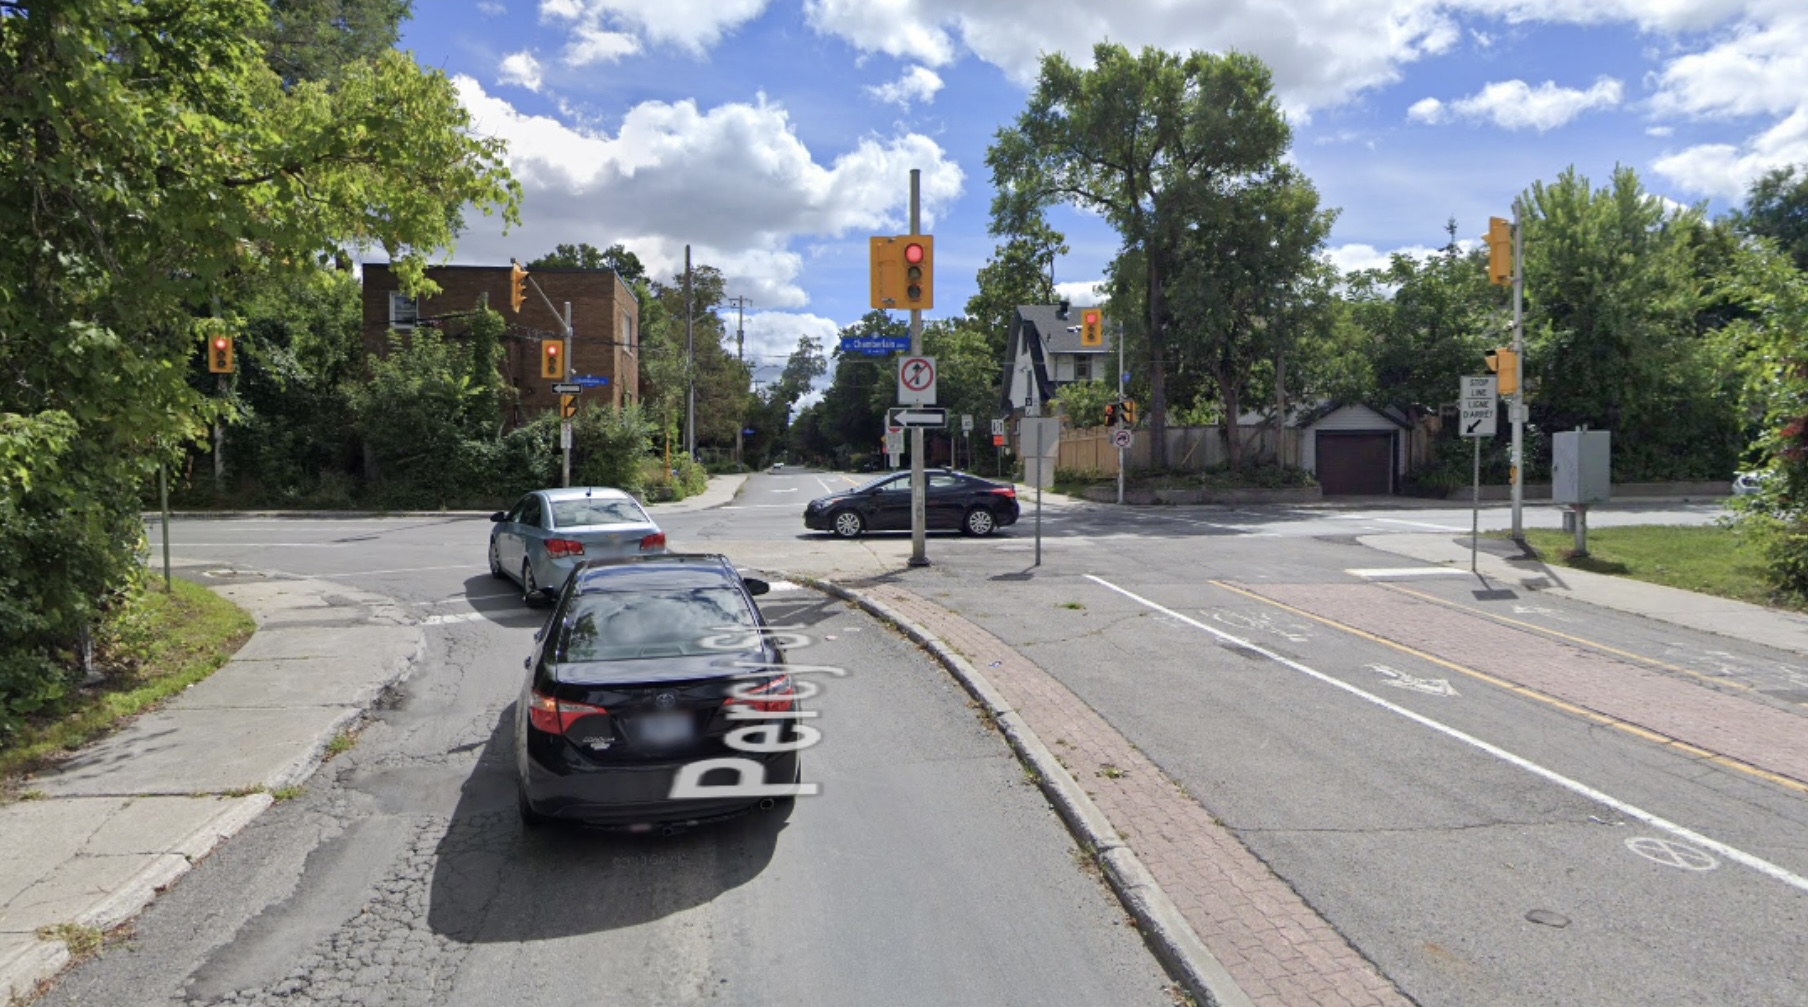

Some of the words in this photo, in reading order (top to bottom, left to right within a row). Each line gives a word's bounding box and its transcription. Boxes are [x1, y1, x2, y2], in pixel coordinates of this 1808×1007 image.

[1470, 379, 1489, 387] STOP
[1471, 388, 1487, 397] LINE
[1468, 400, 1489, 409] LIGNE
